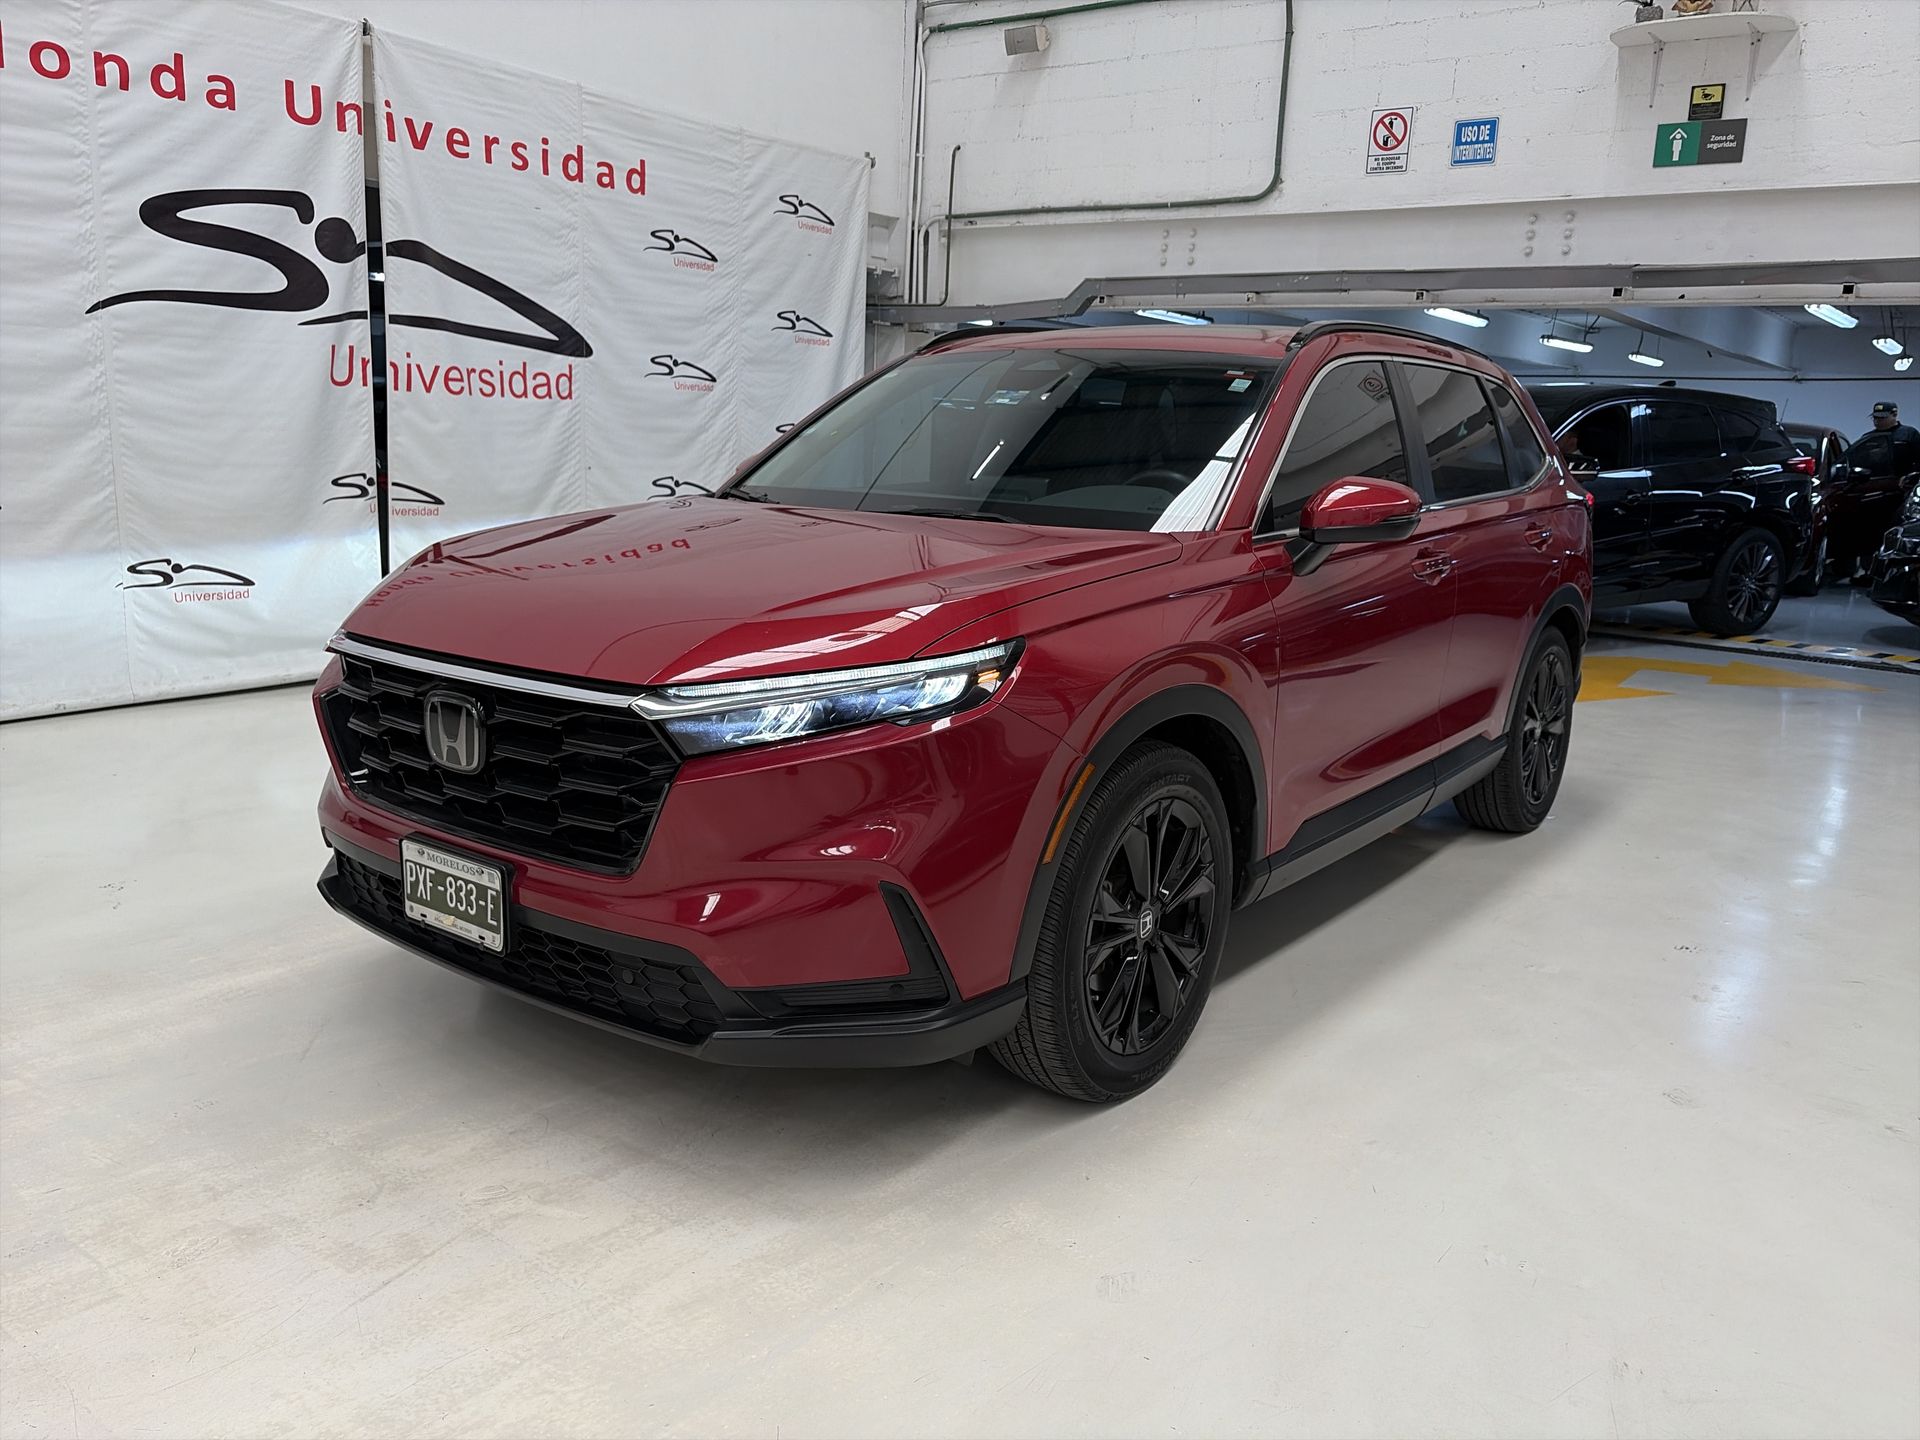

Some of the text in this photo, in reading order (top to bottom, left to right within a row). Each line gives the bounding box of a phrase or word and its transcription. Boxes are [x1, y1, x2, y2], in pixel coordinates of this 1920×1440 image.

[0, 20, 647, 196] onda Universidad
[1461, 124, 1490, 142] USO DE
[1706, 141, 1737, 150] seguridad
[798, 221, 833, 235] Universidad
[673, 258, 715, 272] Universidad
[795, 336, 830, 346] Universidad
[329, 344, 574, 401] Universidad
[674, 381, 714, 392] Universidad
[369, 503, 440, 516] Uiversidad
[173, 588, 251, 603] Universidad
[426, 851, 476, 876] MORELOS
[406, 861, 498, 927] PXF-833-E
